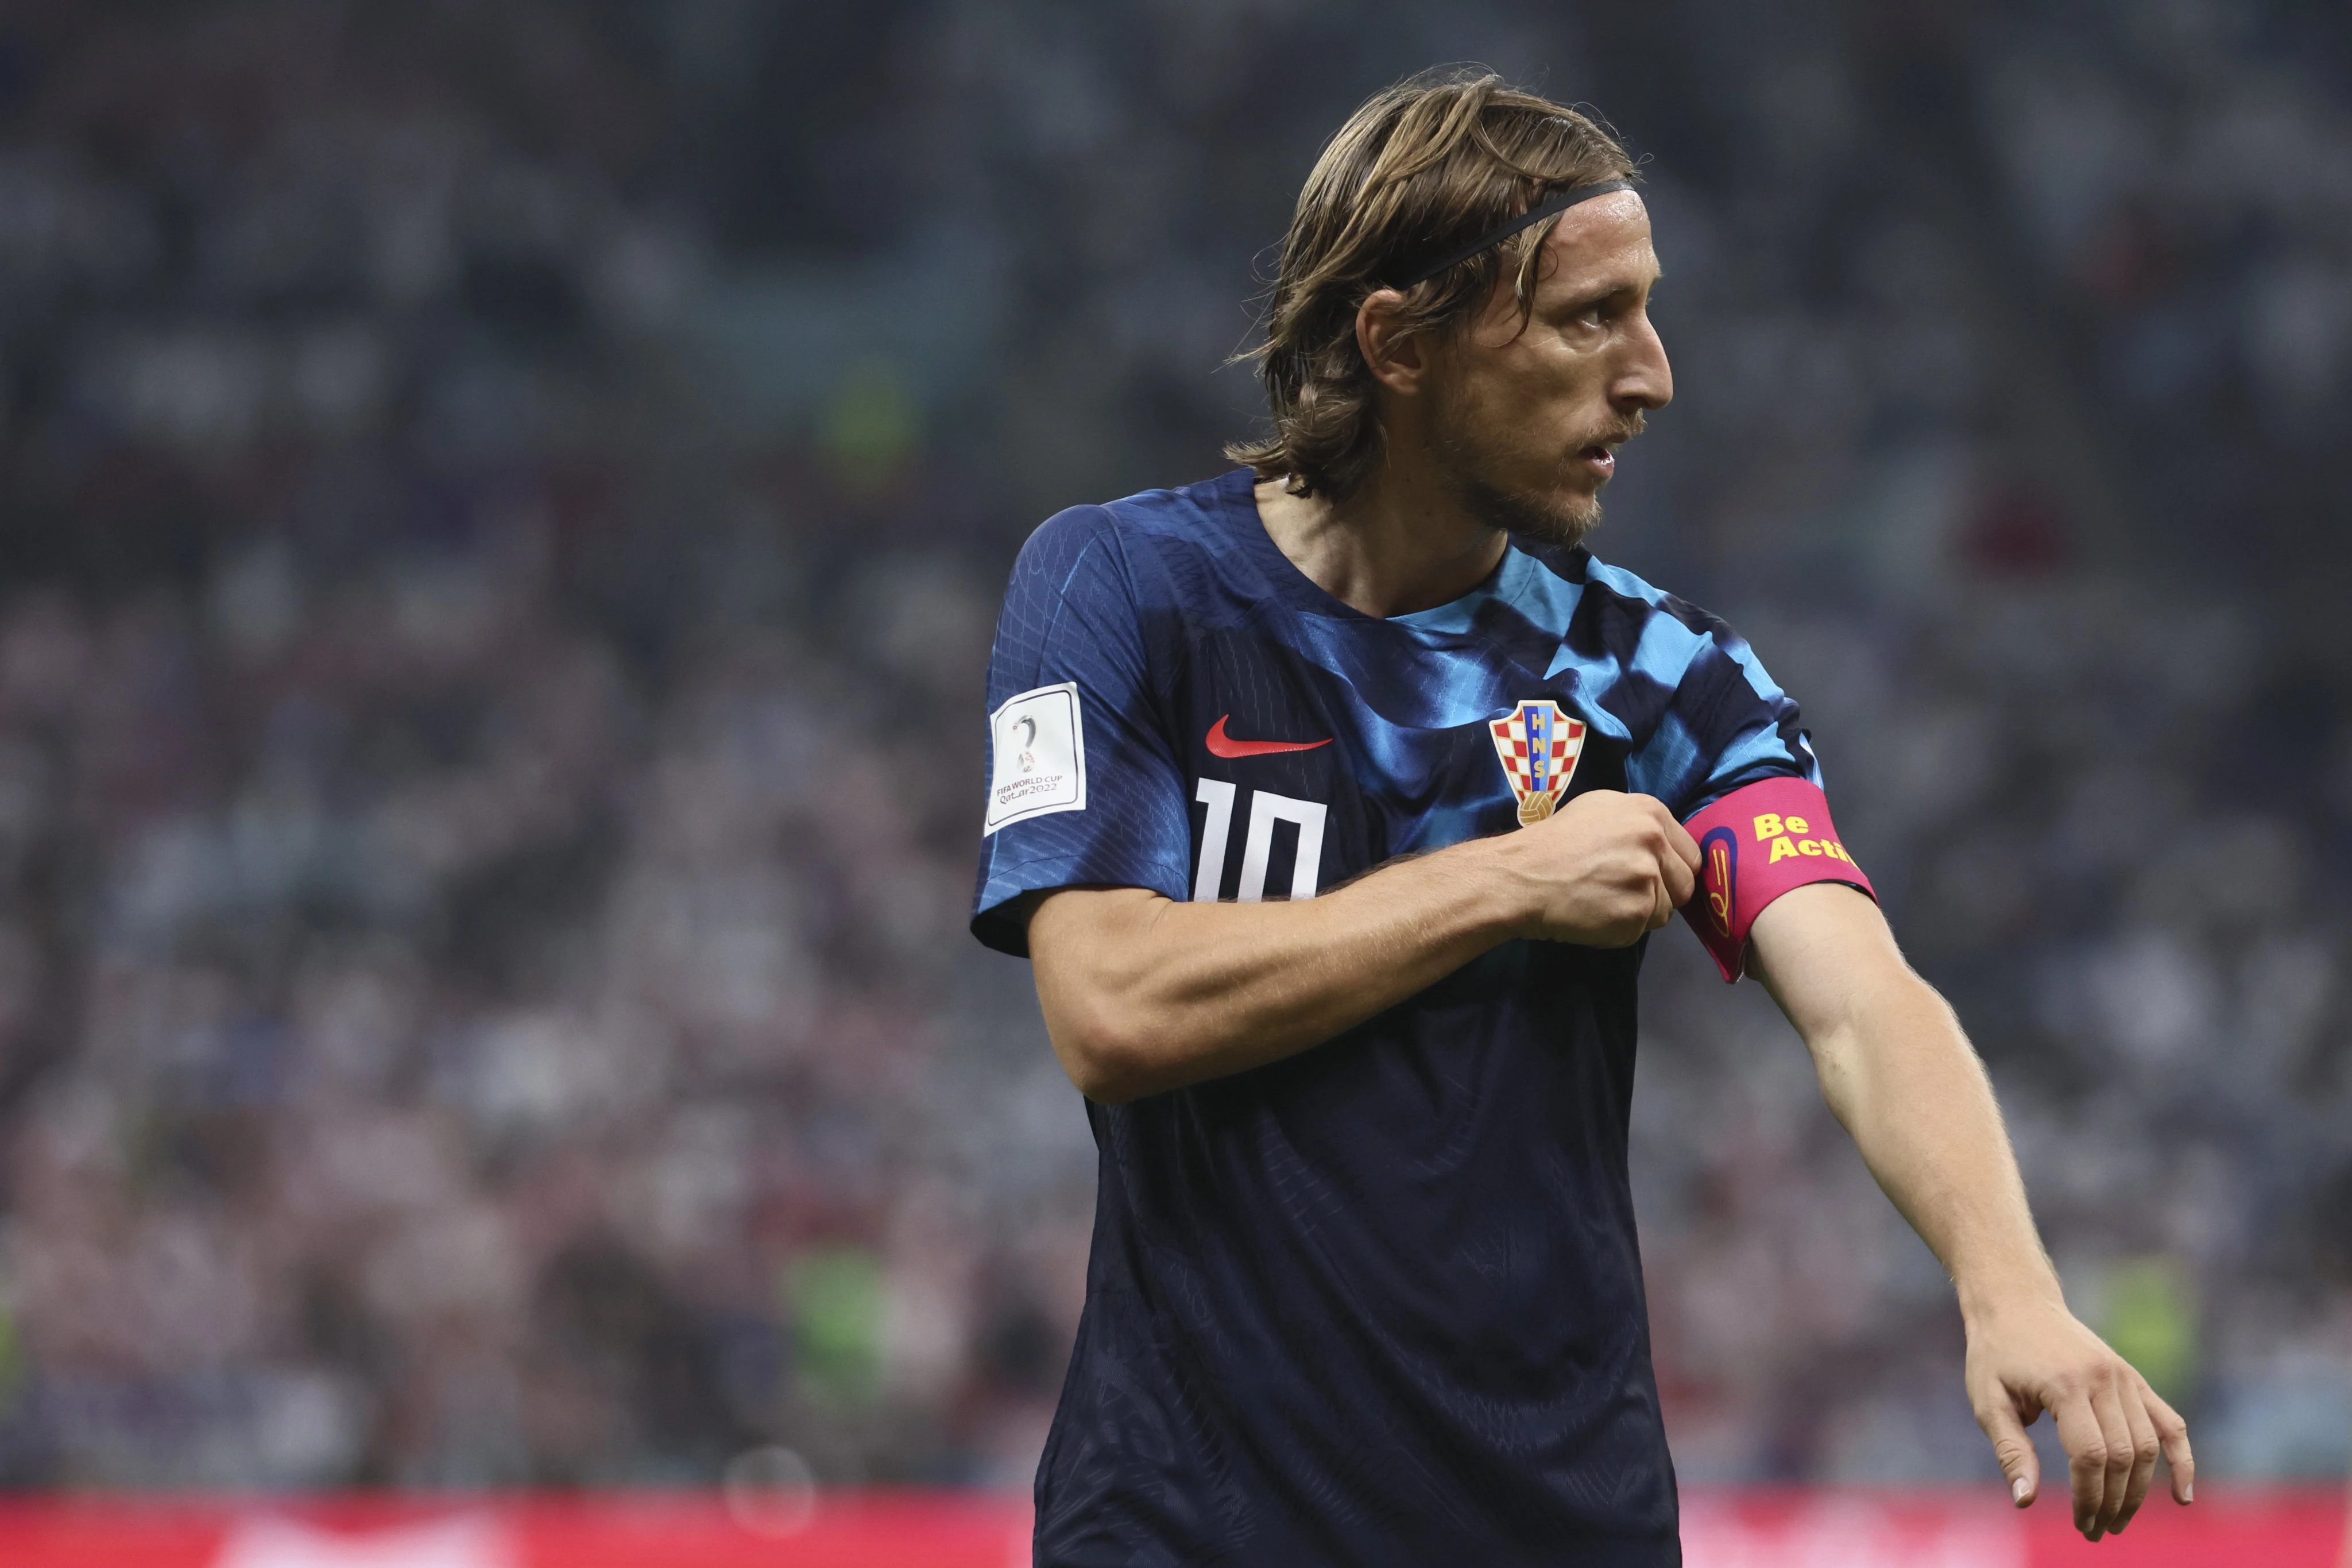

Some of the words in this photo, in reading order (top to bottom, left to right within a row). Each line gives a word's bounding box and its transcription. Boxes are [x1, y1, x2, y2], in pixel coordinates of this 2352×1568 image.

[1531, 714, 1546, 778] HNS
[997, 785, 1011, 796] FIFA
[1012, 777, 1042, 789] WORLD
[1193, 777, 1328, 903] 10
[1753, 813, 1809, 842] Be
[1769, 836, 1860, 870] Acti
